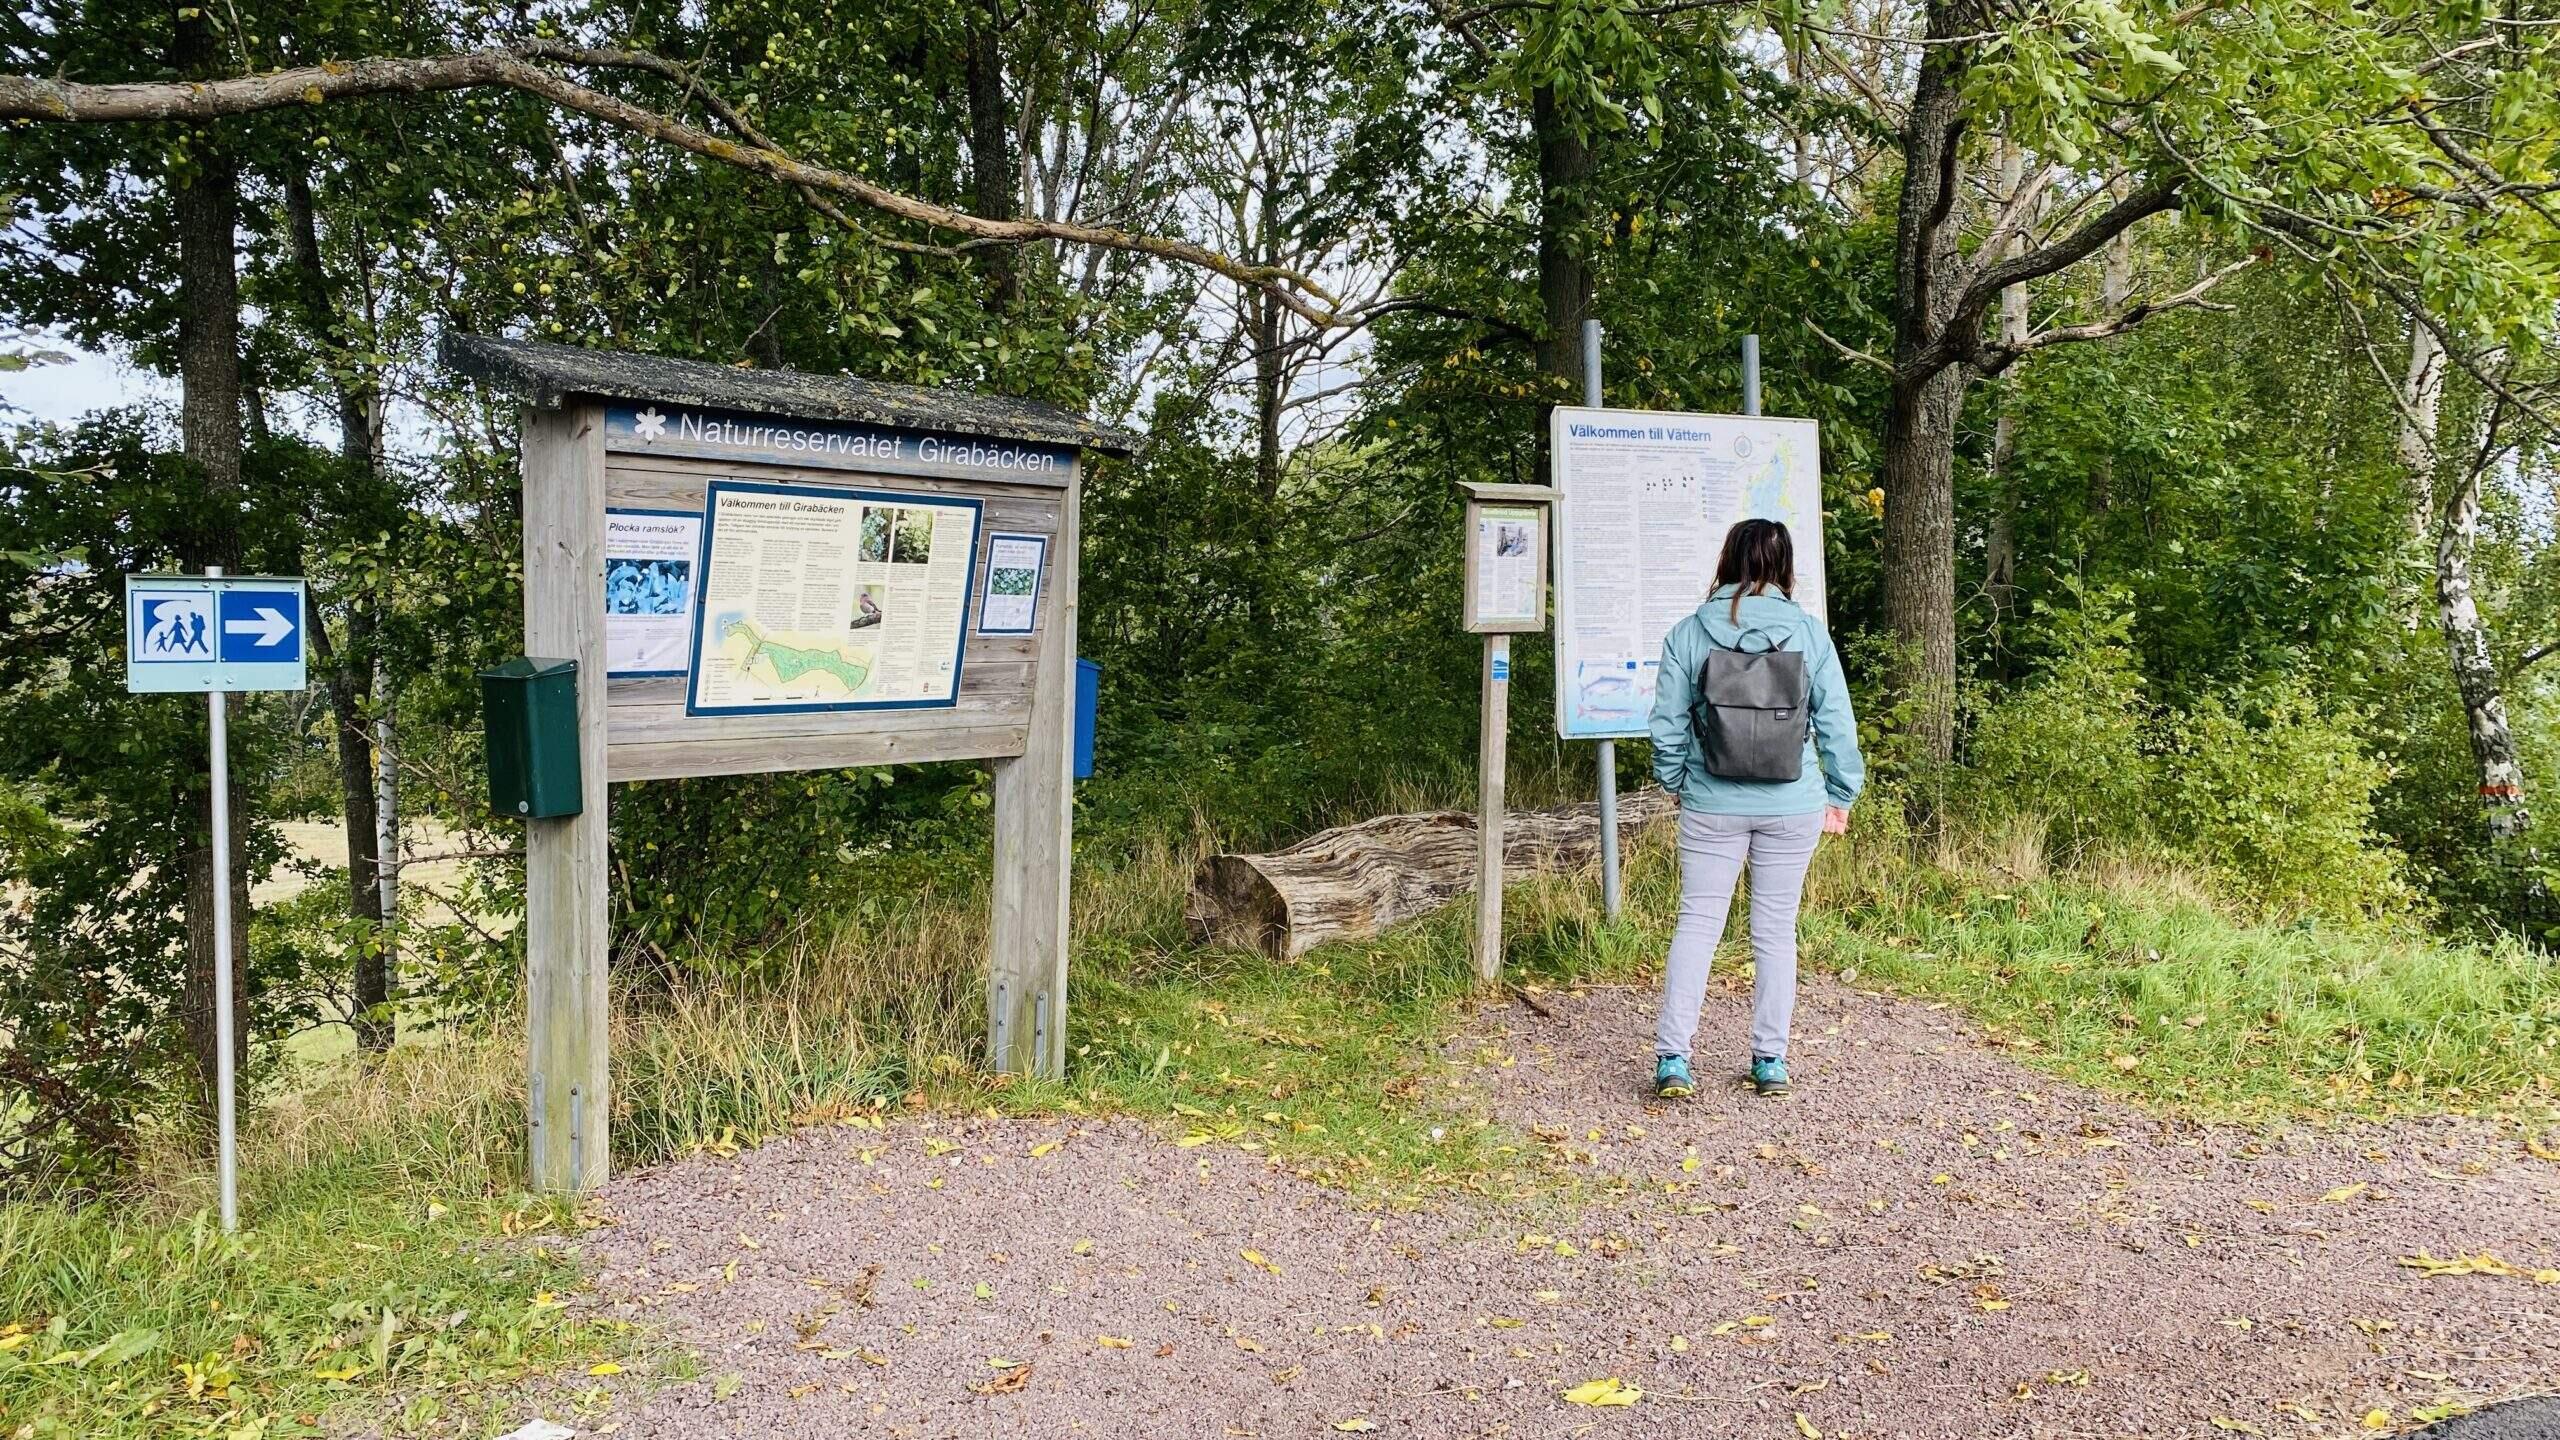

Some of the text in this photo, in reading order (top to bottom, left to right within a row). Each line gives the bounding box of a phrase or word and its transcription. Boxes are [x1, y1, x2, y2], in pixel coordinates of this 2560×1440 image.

[1569, 424, 1712, 442] Välkommen till Vättern
[679, 412, 1054, 473] Naturreservatet Girabäcken
[779, 501, 791, 511] till
[608, 522, 640, 533] Plocka
